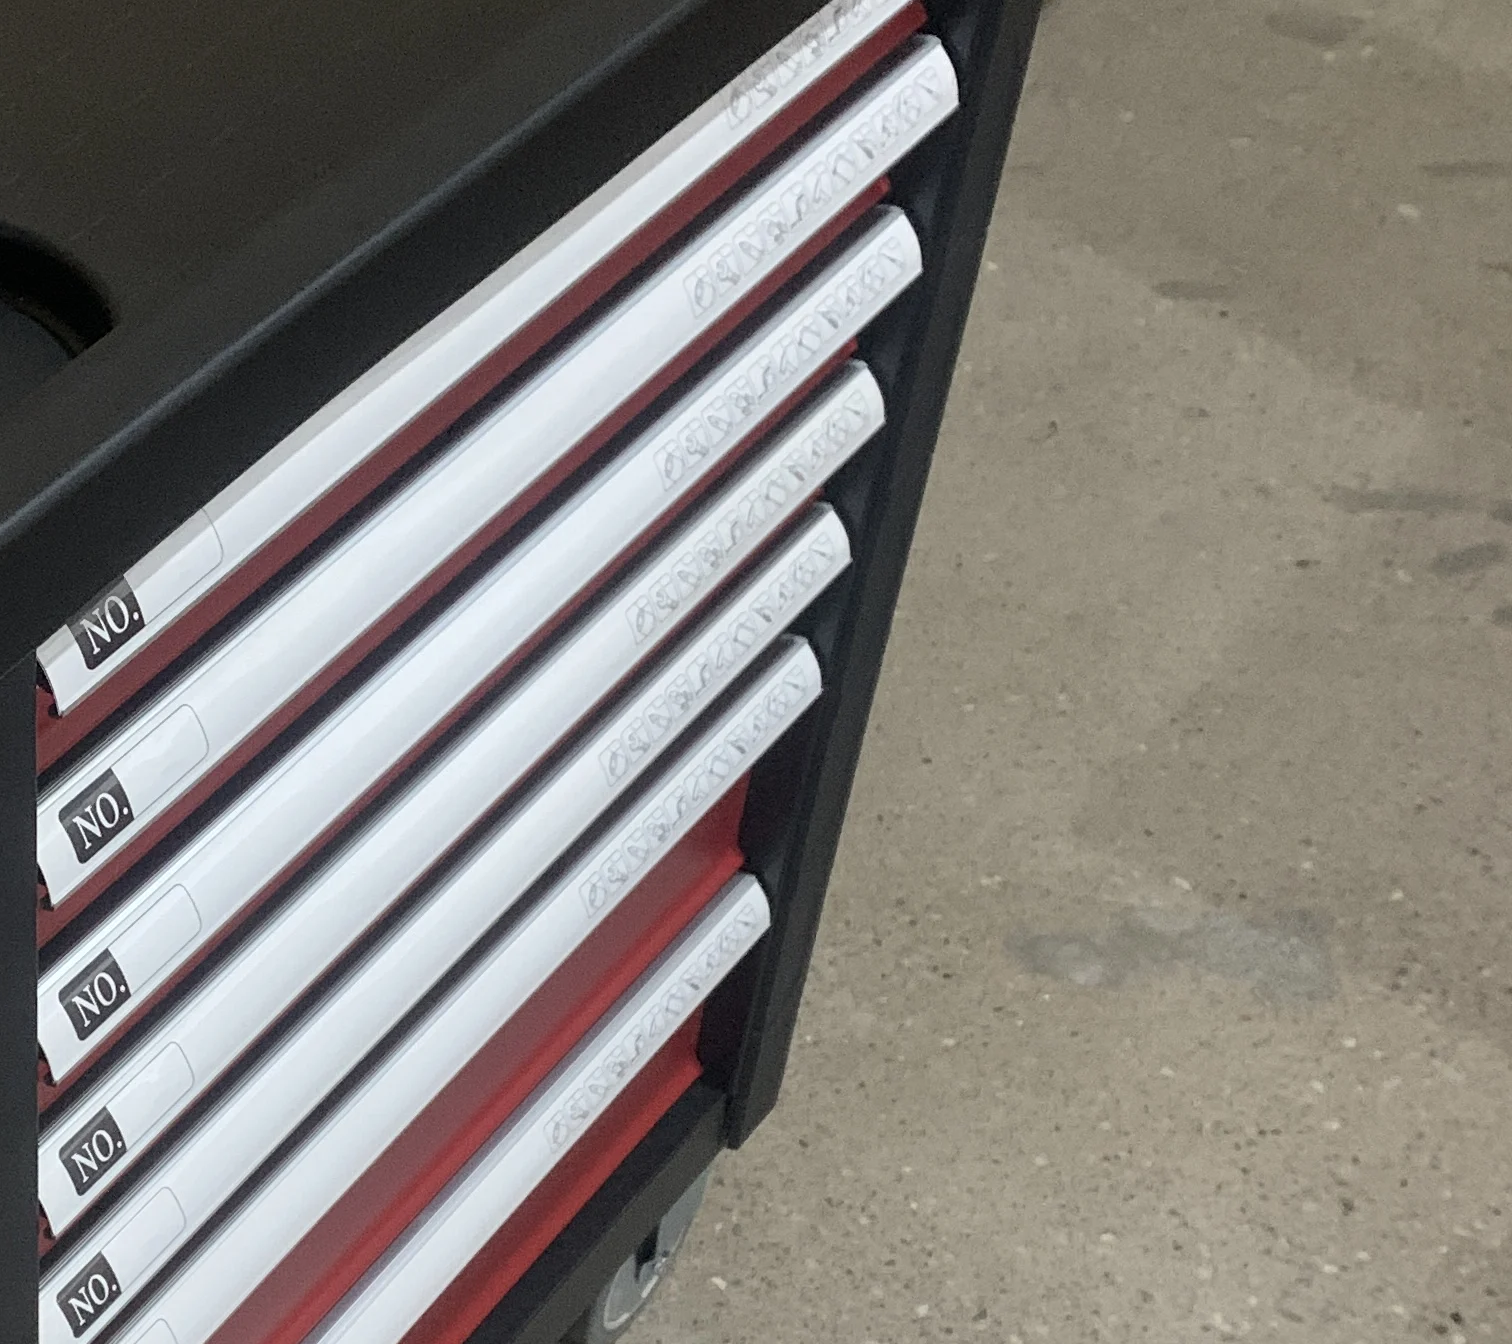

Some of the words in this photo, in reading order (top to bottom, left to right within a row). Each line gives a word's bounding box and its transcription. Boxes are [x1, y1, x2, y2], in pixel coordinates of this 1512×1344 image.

[79, 595, 140, 655] NO.
[71, 792, 129, 850] NO.
[70, 971, 126, 1028] NO.
[70, 1128, 123, 1183] NO.
[68, 1272, 118, 1327] NO.
